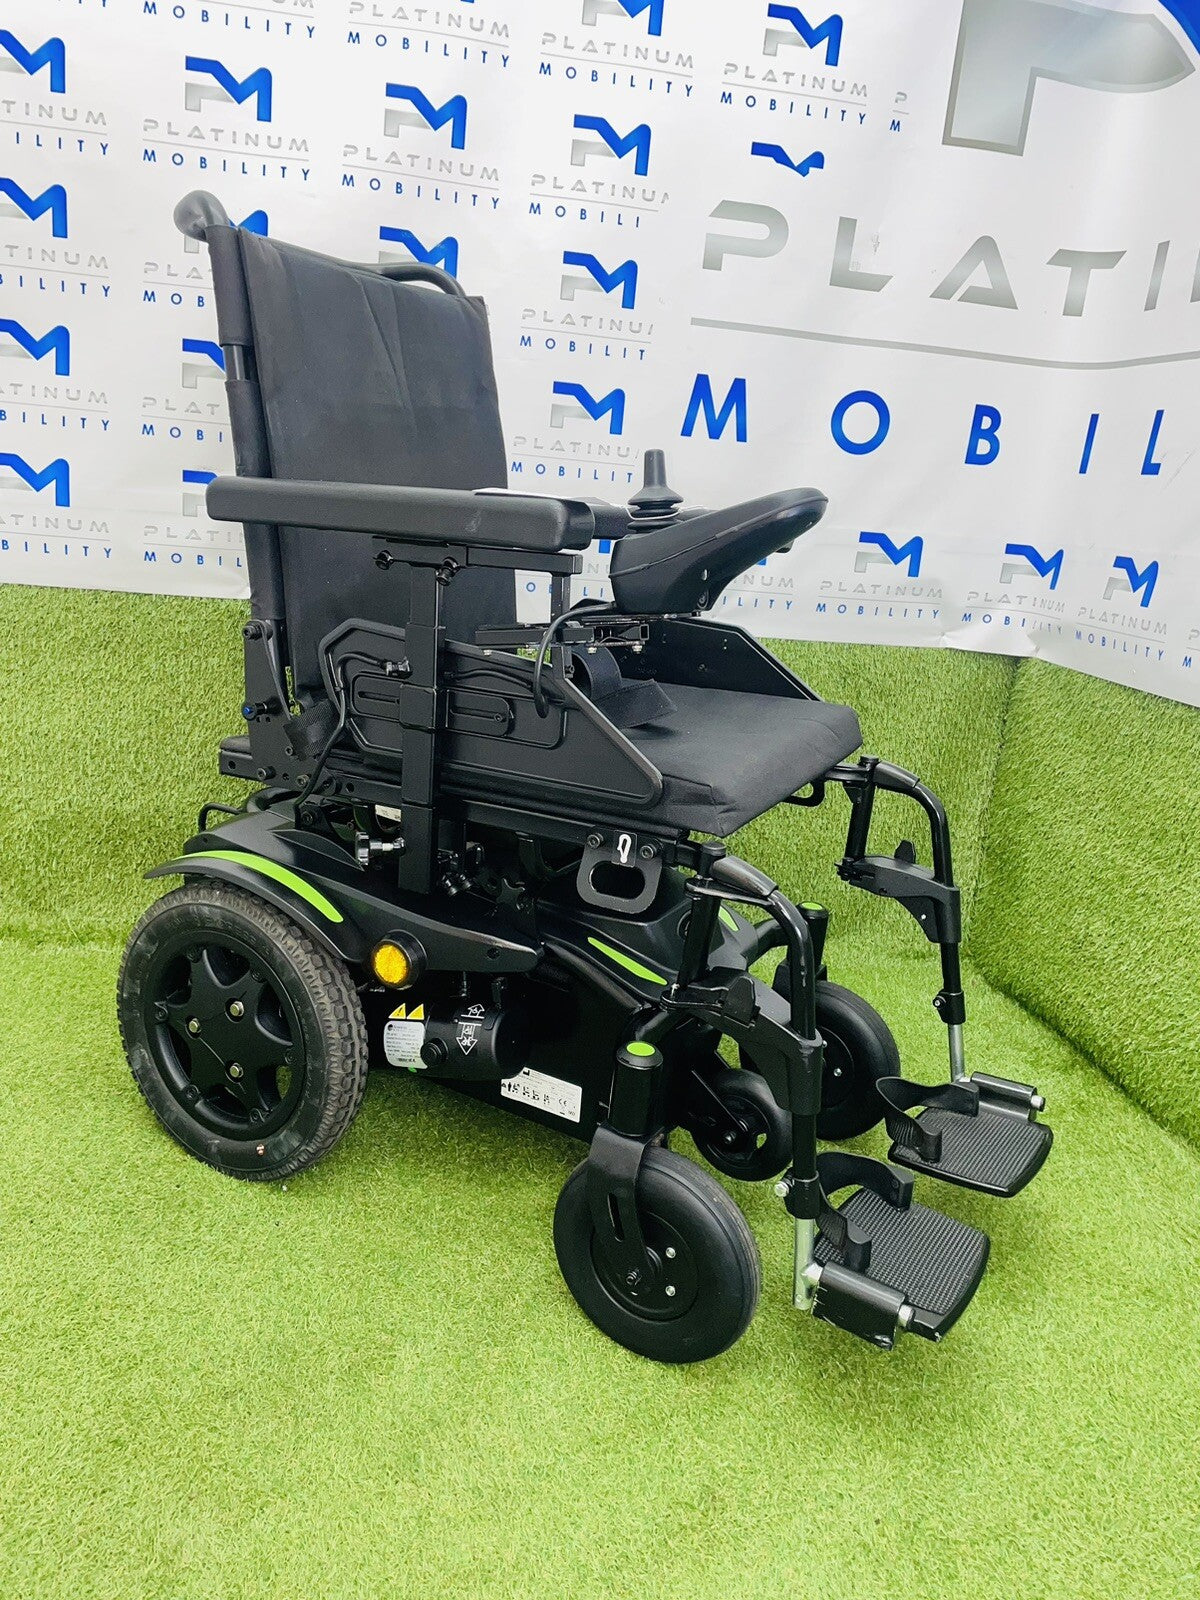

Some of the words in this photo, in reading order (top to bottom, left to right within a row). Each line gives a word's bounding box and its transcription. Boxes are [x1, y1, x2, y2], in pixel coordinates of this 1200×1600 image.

[143, 1, 315, 38] MOBILITY
[349, 1, 509, 38] PLATINUM
[347, 31, 509, 68] MOBILITY
[541, 32, 694, 69] PLATINUM
[539, 62, 693, 97] MOBILITY
[724, 62, 868, 97] PLATINUM
[720, 91, 866, 125] MOBILITY
[143, 118, 309, 152] PLATINUM
[143, 148, 310, 181] MOBILITY
[343, 144, 499, 181] PLATINUM
[342, 174, 499, 209] MOBILITY
[529, 202, 640, 228] MOBILI
[143, 261, 212, 280] PLA
[702, 199, 1200, 317] PLATI
[521, 308, 654, 335] PLATINU
[520, 335, 645, 360] MOBILIT
[680, 373, 1165, 476] MOBIL
[513, 435, 640, 460] PLATINU
[511, 461, 632, 483] MOBILIT
[143, 551, 242, 568] MOBIL
[819, 580, 943, 599] PLATINUM
[966, 591, 1067, 613] PLATINUM
[815, 602, 940, 619] MOBILITY
[1077, 606, 1168, 636] PLATINUM
[1075, 630, 1166, 661] MOBILITY
